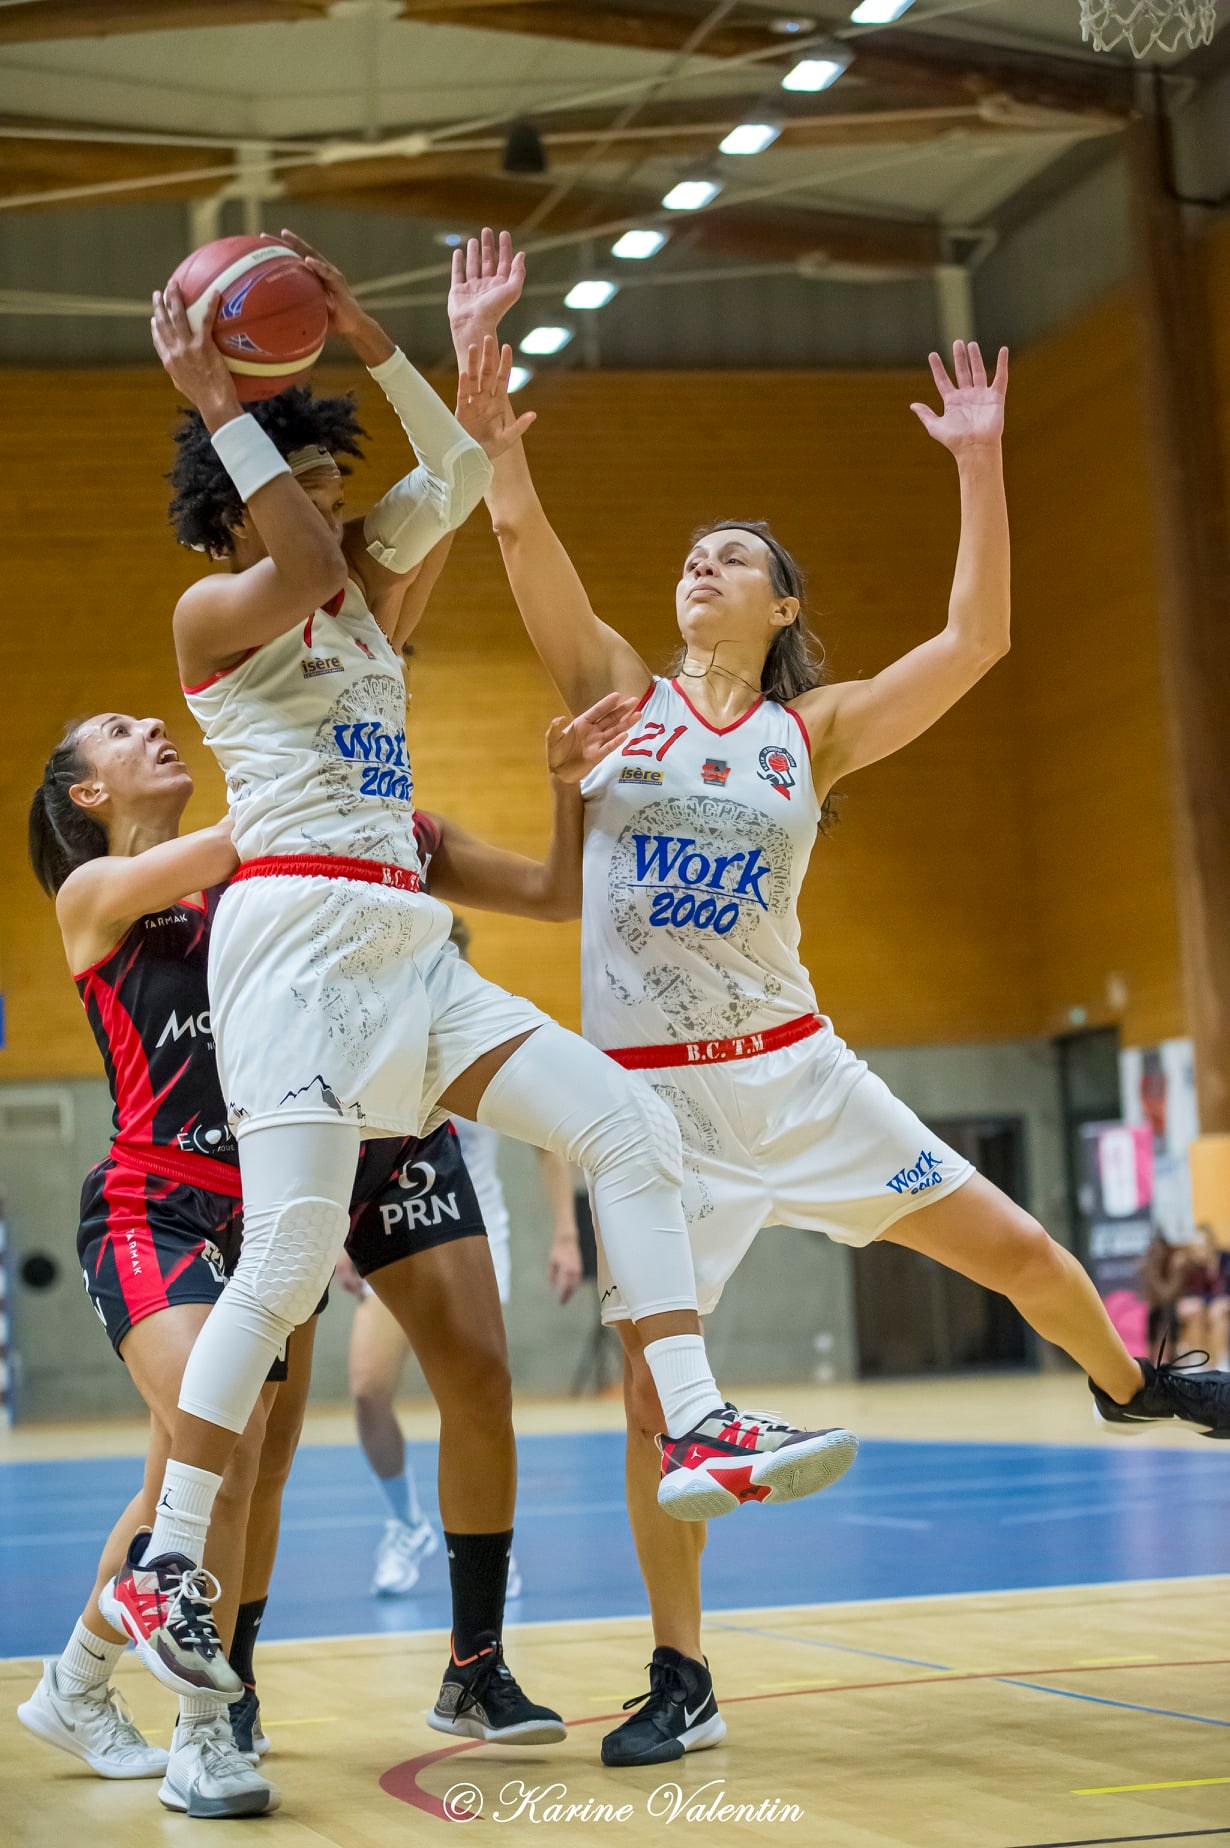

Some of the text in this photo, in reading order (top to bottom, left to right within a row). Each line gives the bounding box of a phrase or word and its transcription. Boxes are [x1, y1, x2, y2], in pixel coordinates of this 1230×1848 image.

[302, 657, 341, 673] isère
[333, 721, 411, 770] Wor
[622, 722, 688, 762] 21
[621, 766, 662, 781] isère
[632, 834, 771, 912] Work
[144, 913, 188, 929] TARMAK
[650, 892, 739, 935] 2000
[886, 1150, 943, 1194] Work
[379, 1192, 461, 1236] PRN
[125, 1228, 142, 1276] TARMAK
